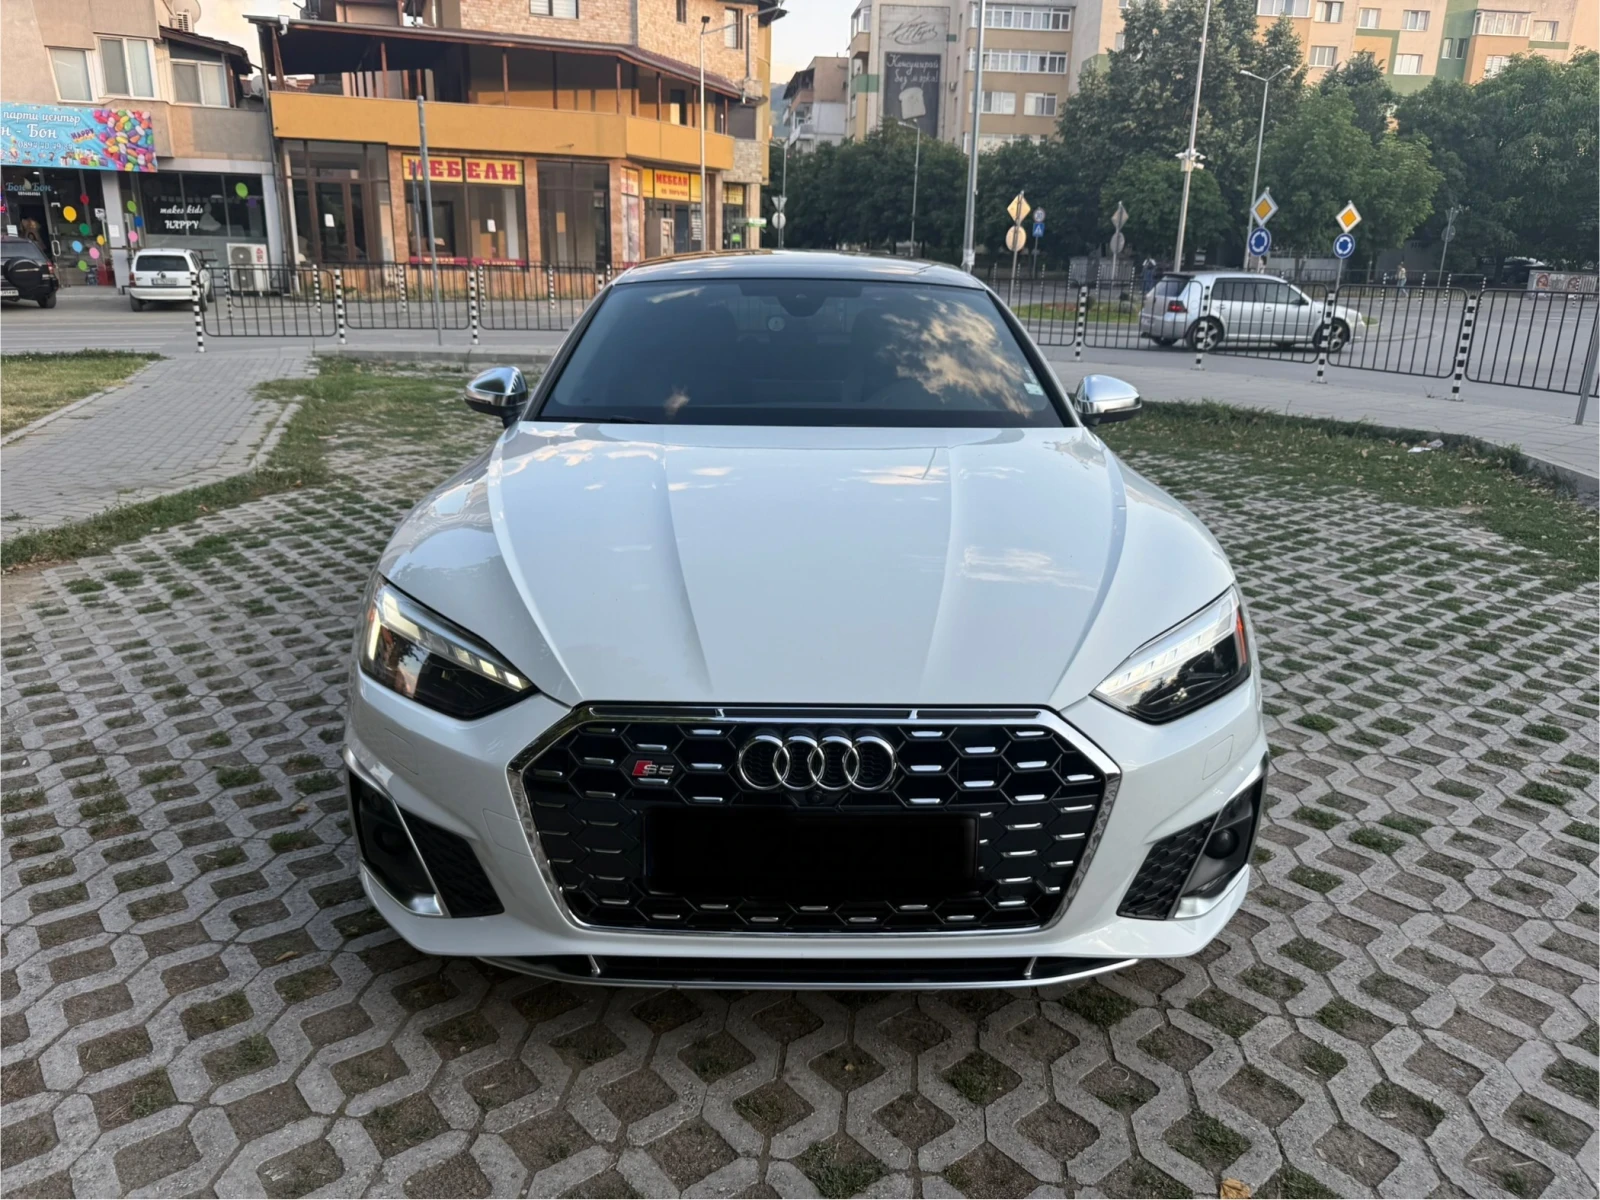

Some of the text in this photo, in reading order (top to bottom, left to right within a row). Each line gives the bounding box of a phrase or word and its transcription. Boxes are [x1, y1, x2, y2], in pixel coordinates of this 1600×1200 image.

[3, 111, 80, 126] парти център
[27, 123, 57, 138] Бон
[408, 158, 516, 180] МЕБЕЛИ
[160, 204, 203, 214] makes kids
[164, 220, 199, 229] HAPPY
[643, 764, 674, 775] S5
